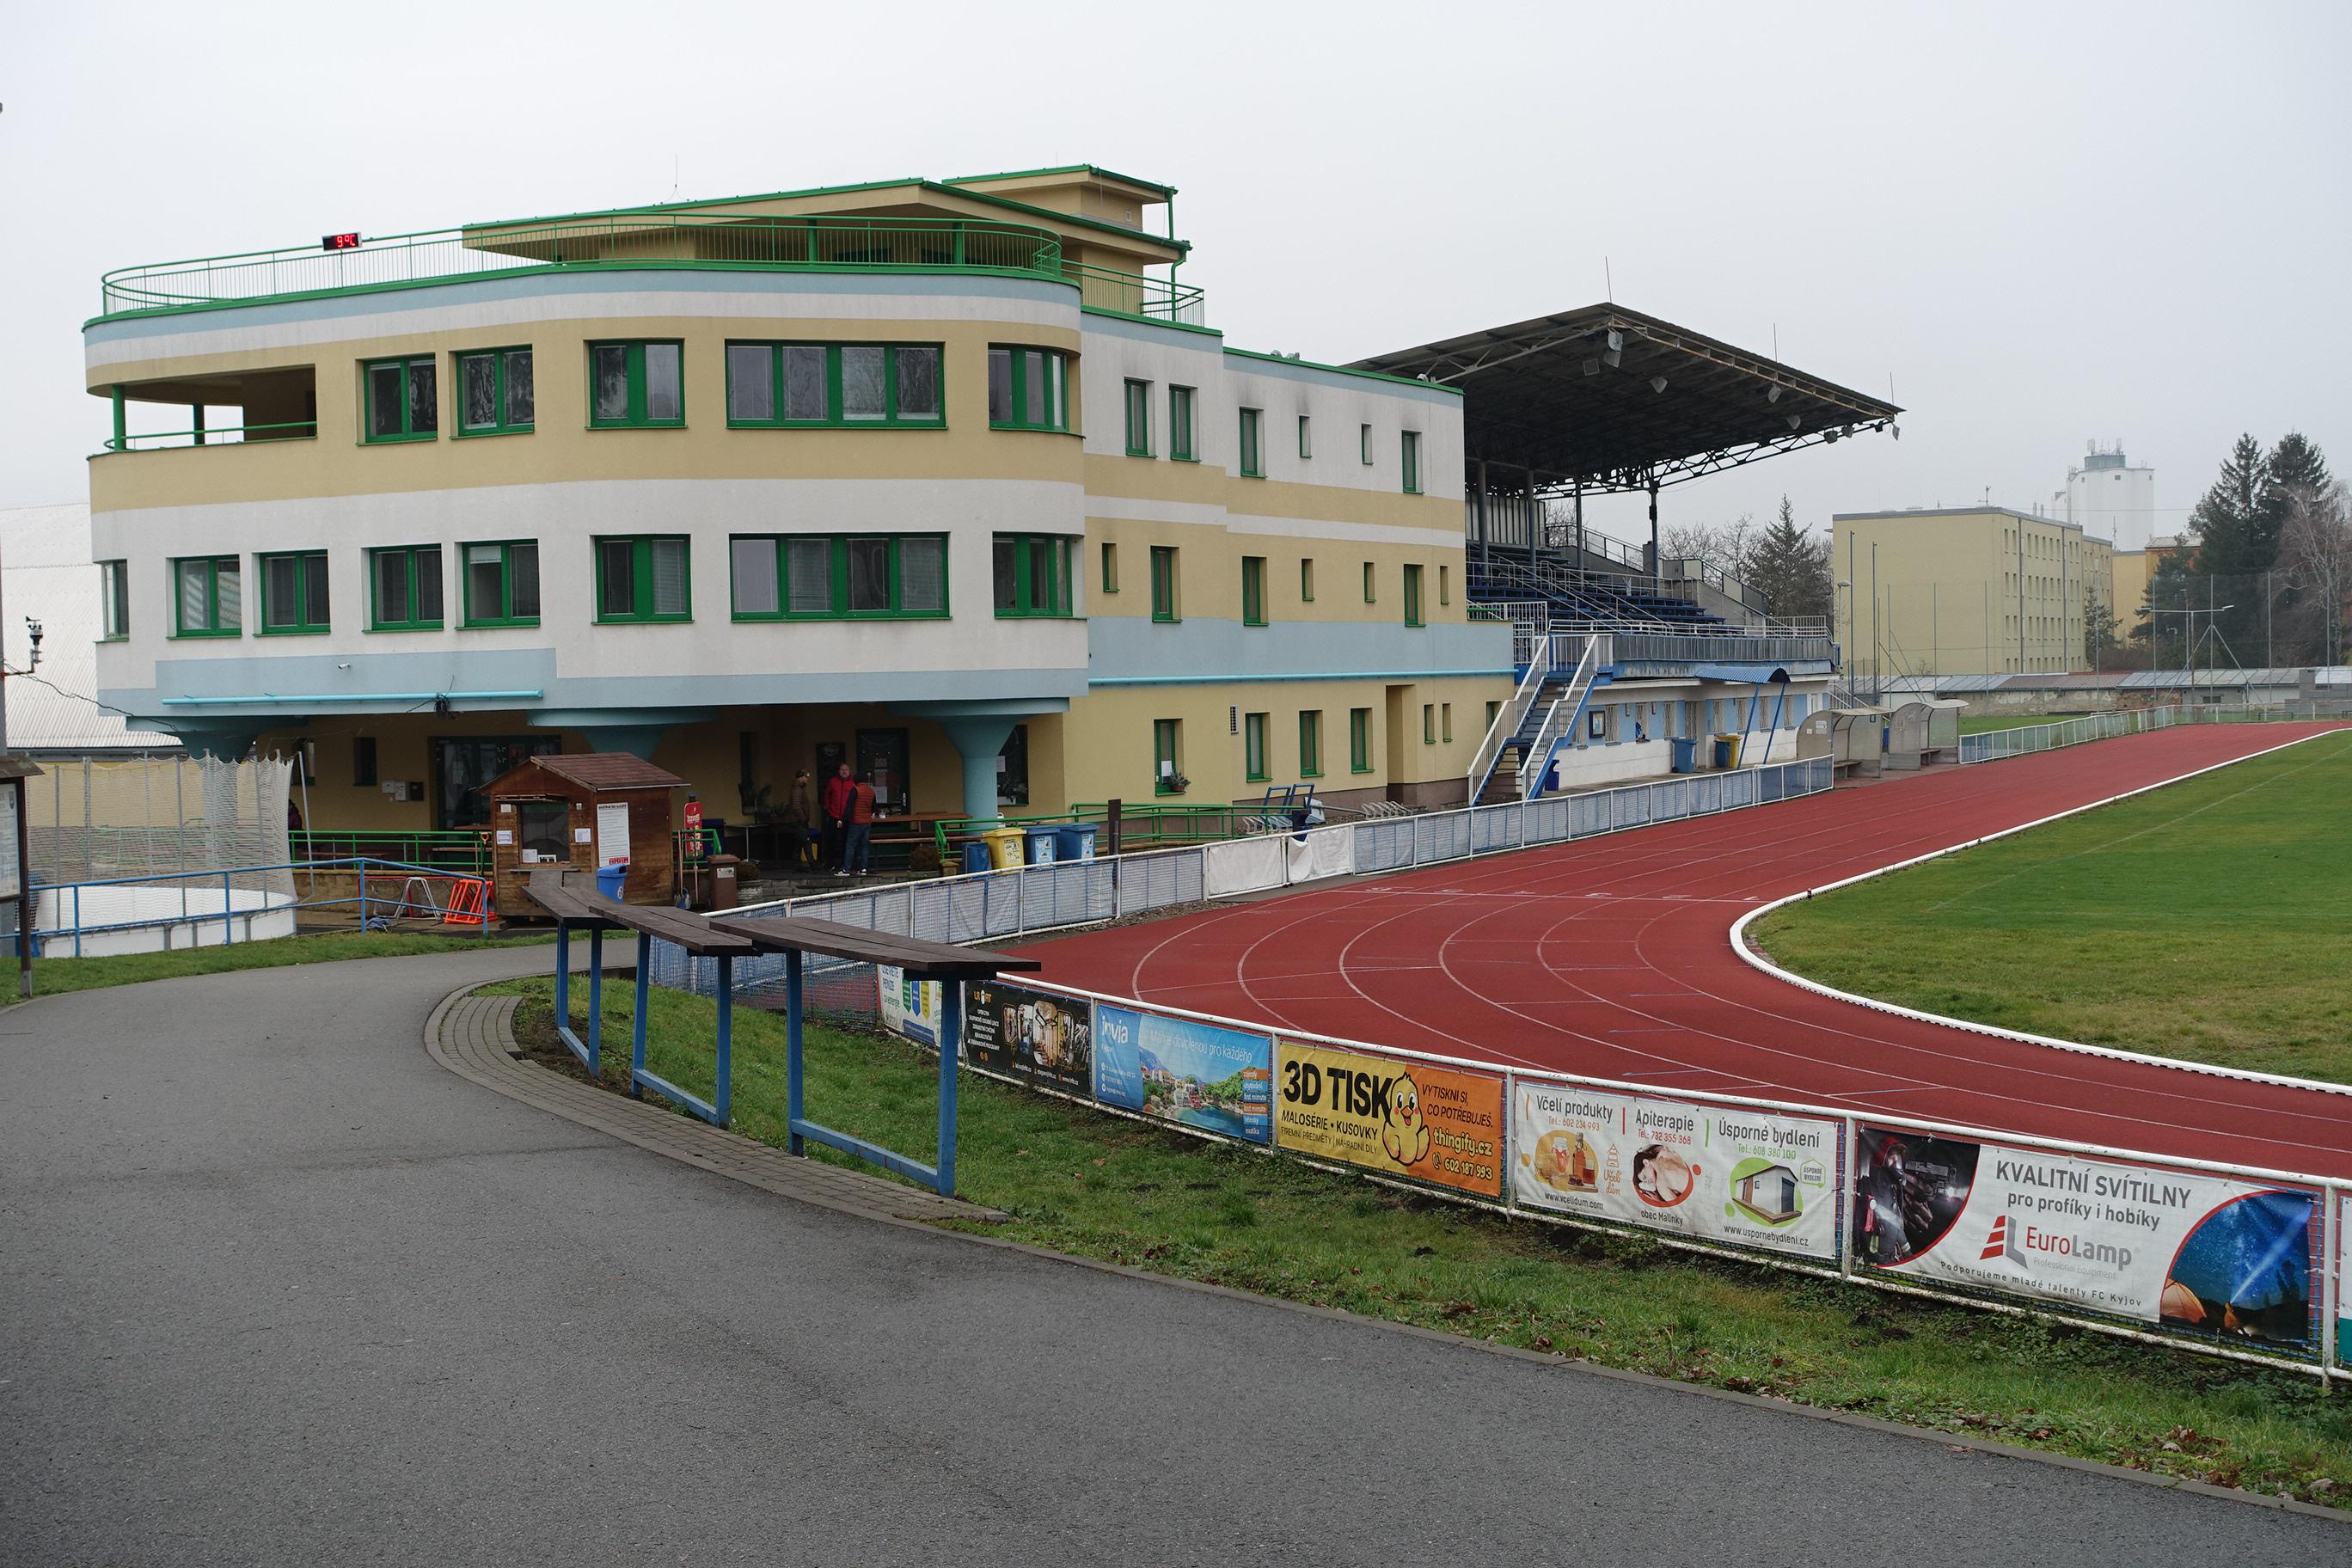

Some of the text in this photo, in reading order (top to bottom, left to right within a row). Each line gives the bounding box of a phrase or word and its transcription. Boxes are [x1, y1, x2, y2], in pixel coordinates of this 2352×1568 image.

[1101, 1015, 1128, 1044] invia
[1209, 1044, 1222, 1057] pro
[1222, 1044, 1253, 1063] každého
[1252, 1093, 1267, 1101] minute
[1283, 1060, 1394, 1126] 3D TISK
[1422, 1084, 1469, 1106] VYTISKNI SI,
[1427, 1104, 1493, 1128] CO POTŘEBUJEŠ.
[1536, 1094, 1614, 1123] Včelí produkty
[1281, 1110, 1378, 1141] MALOSÉRIE KUSOVKY
[1548, 1115, 1601, 1131] Tel.: 602 234 993
[1635, 1109, 1694, 1134] Apiterapie
[1719, 1118, 1822, 1148] Úsporné bydlení
[1281, 1126, 1378, 1155] FIREMNÍ PŘEDMĚTY NÁHRADNÍ DÍLY
[1433, 1127, 1493, 1158] thingify.cz
[1651, 1130, 1663, 1142] 732
[1663, 1132, 1676, 1143] 355
[1678, 1134, 1692, 1145] 368
[1737, 1142, 1751, 1155] Tel.:
[1767, 1148, 1781, 1158] 380
[1782, 1149, 1796, 1160] 100
[1444, 1157, 1493, 1180] 602 187 993
[1996, 1160, 2191, 1209] KVALITNÍ SVÍTILNY
[1544, 1191, 1603, 1210] www.vcelidum.com
[2008, 1192, 2160, 1231] pro profíky i hobíky
[1640, 1210, 1683, 1227] obec Malinky
[1724, 1224, 1809, 1246] www.uspornebydleni.cz
[2026, 1226, 2132, 1271] EuroLamp
[2033, 1258, 2118, 1280] Professional Equipment
[1940, 1261, 2142, 1307] Podporujeme mladé talenty FC Kyjov
